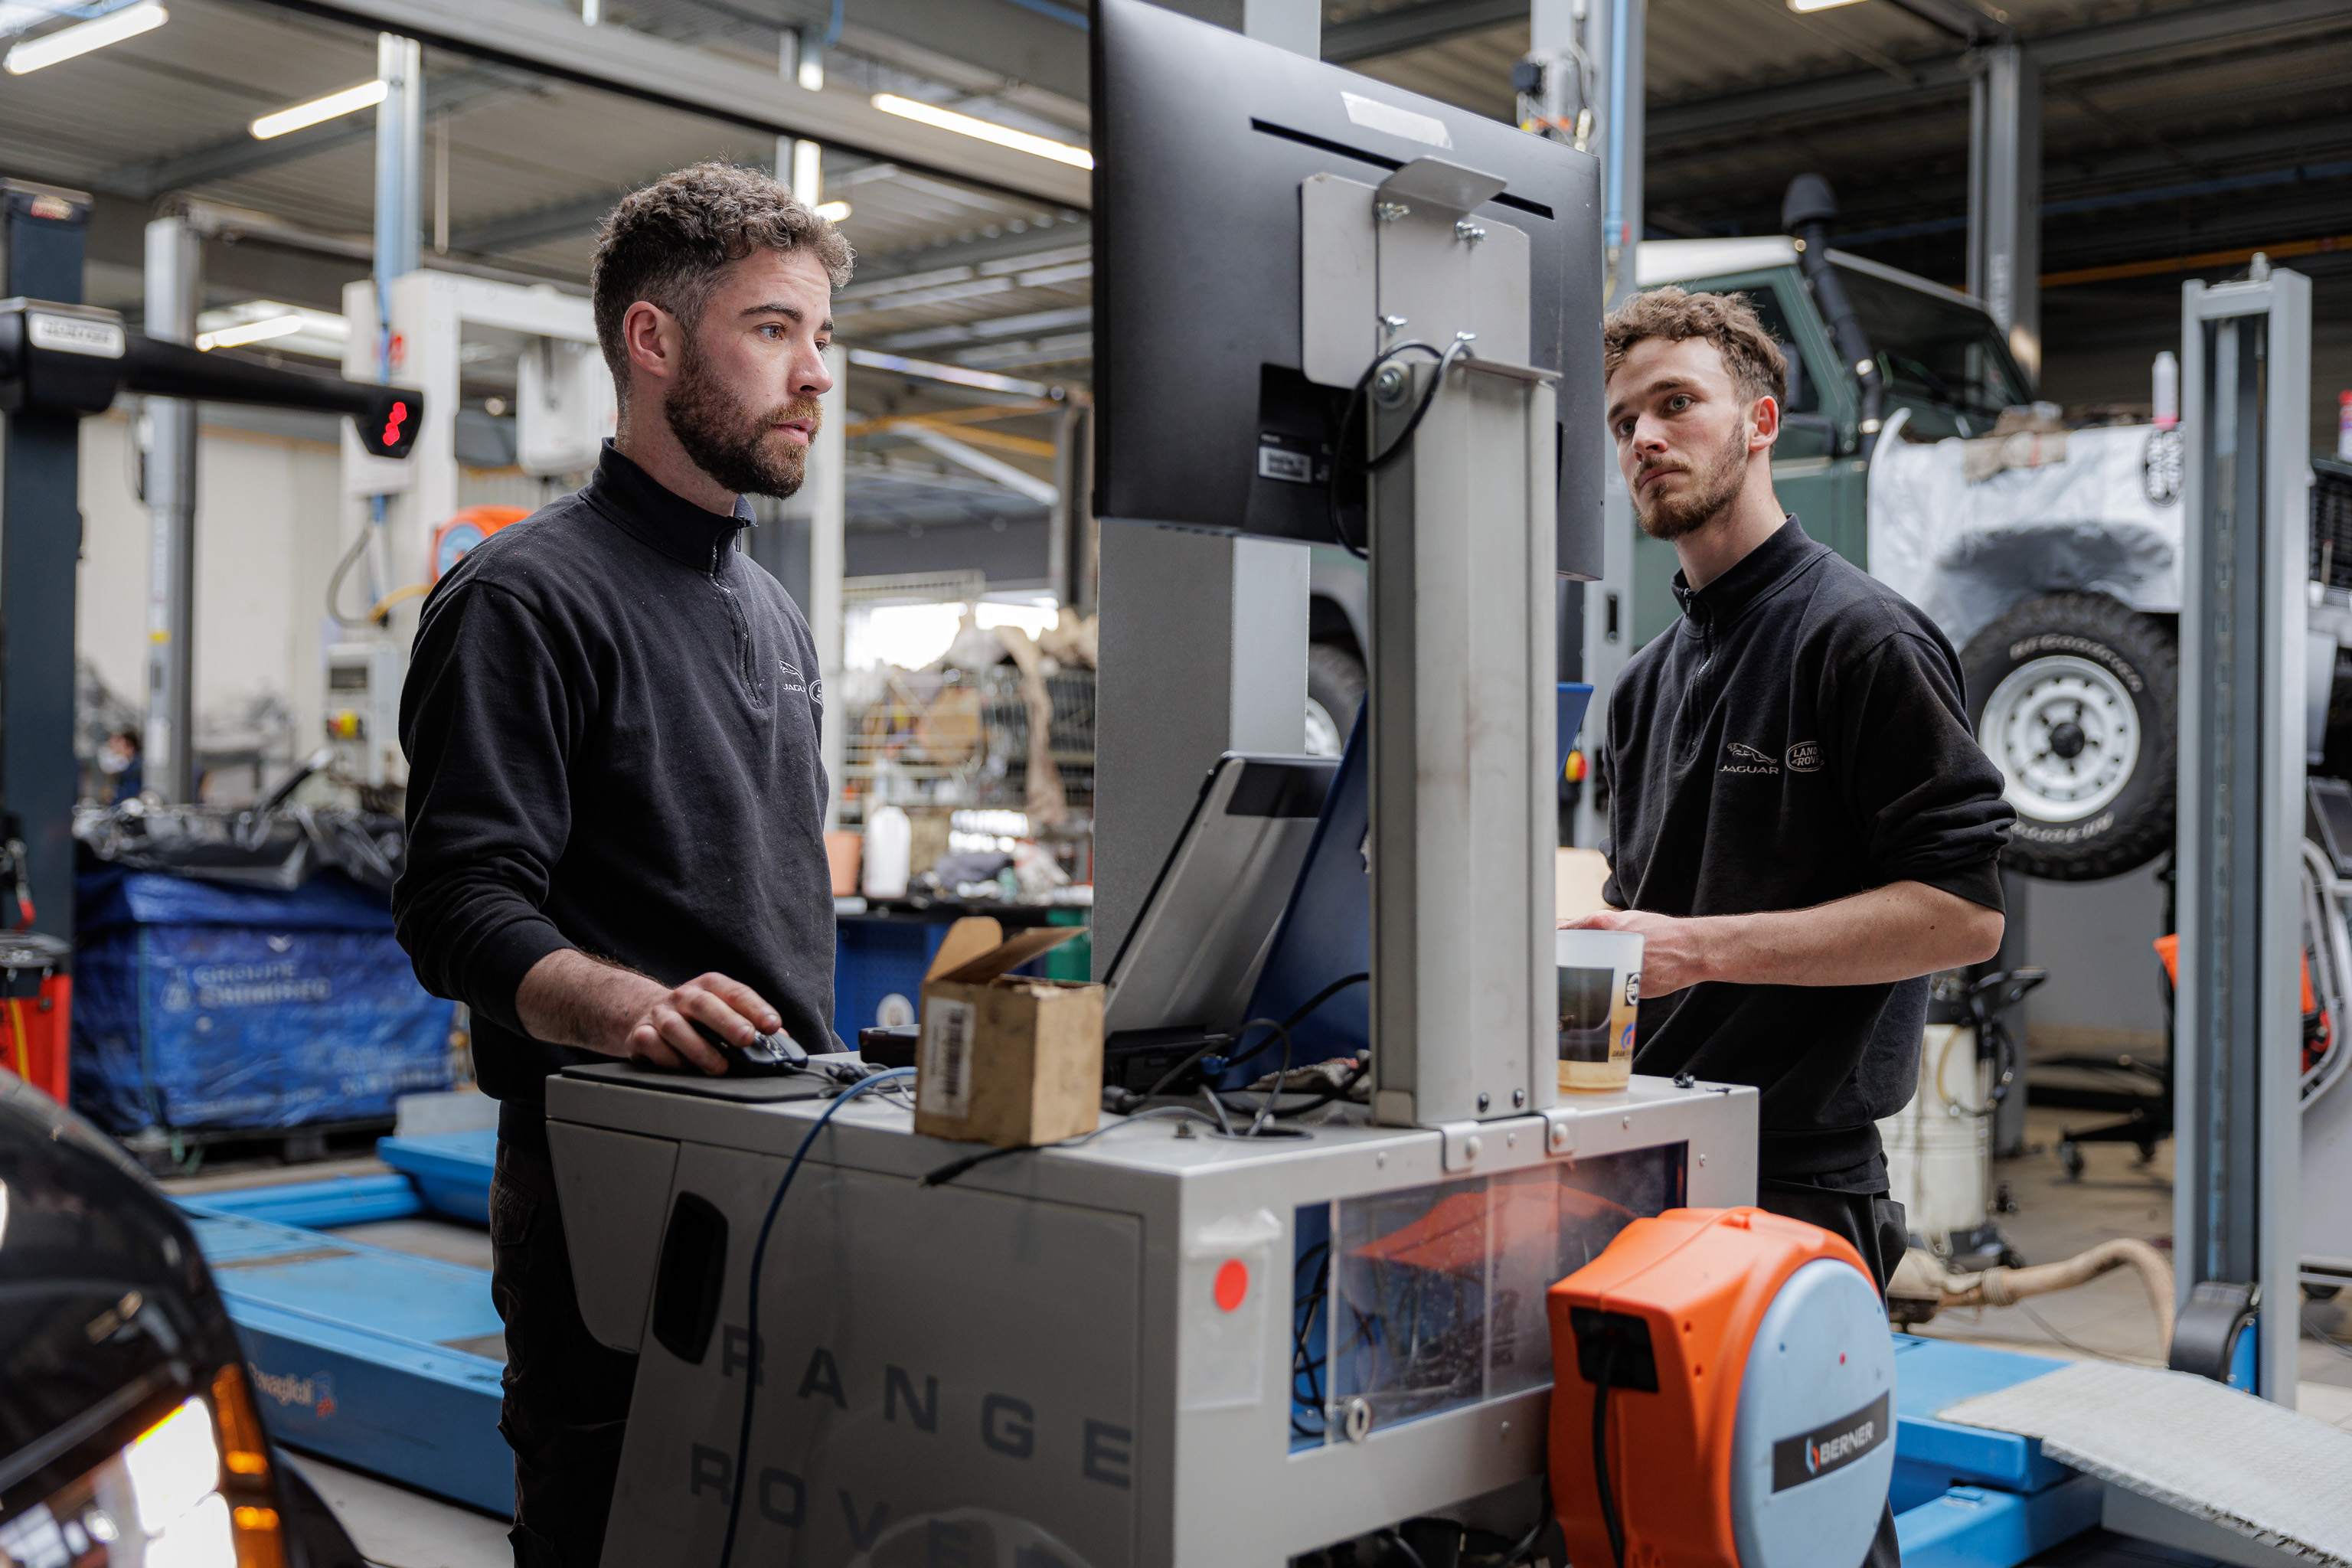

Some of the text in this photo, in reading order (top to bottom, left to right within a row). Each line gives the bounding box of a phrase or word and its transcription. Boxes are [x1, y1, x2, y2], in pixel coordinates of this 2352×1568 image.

[782, 683, 806, 693] JAGU
[1792, 746, 1818, 758] LAND
[1796, 755, 1820, 766] ROVE
[1718, 765, 1779, 774] JAGUAR
[722, 1323, 1132, 1491] RANGE
[1820, 1420, 1875, 1465] BERNER
